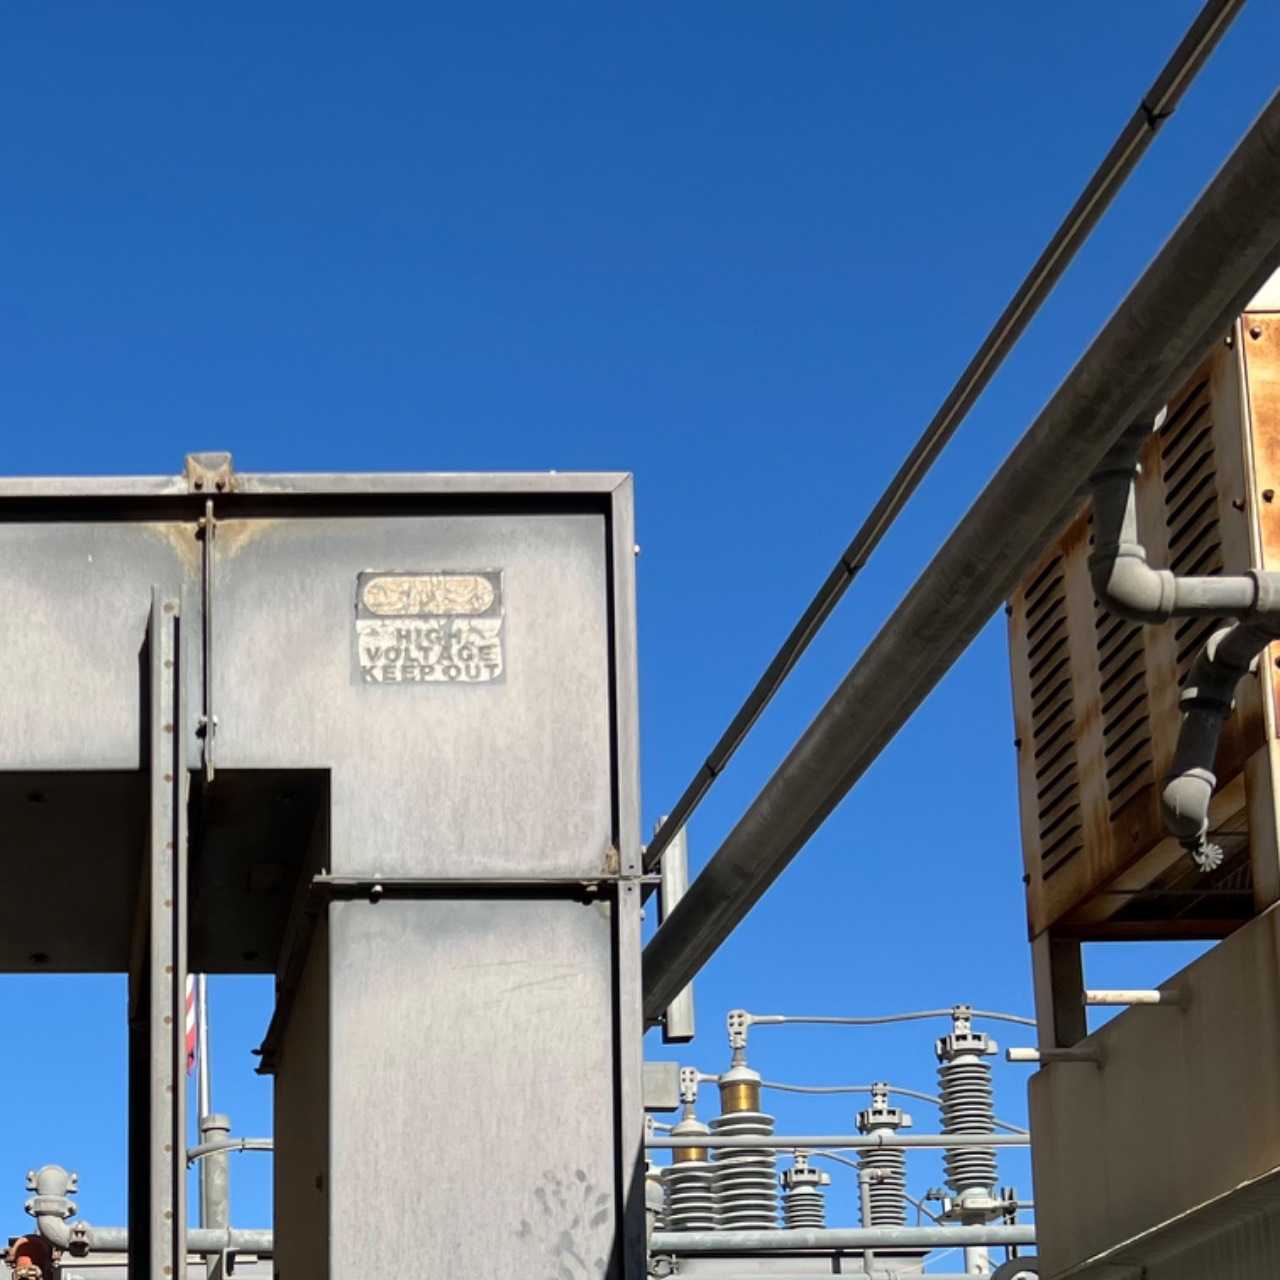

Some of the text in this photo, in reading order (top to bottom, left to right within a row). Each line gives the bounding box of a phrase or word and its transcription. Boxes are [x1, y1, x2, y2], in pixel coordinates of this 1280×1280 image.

[395, 628, 462, 646] HIGH
[365, 644, 499, 664] VOLTAGE
[361, 664, 499, 683] KEEP OUT
